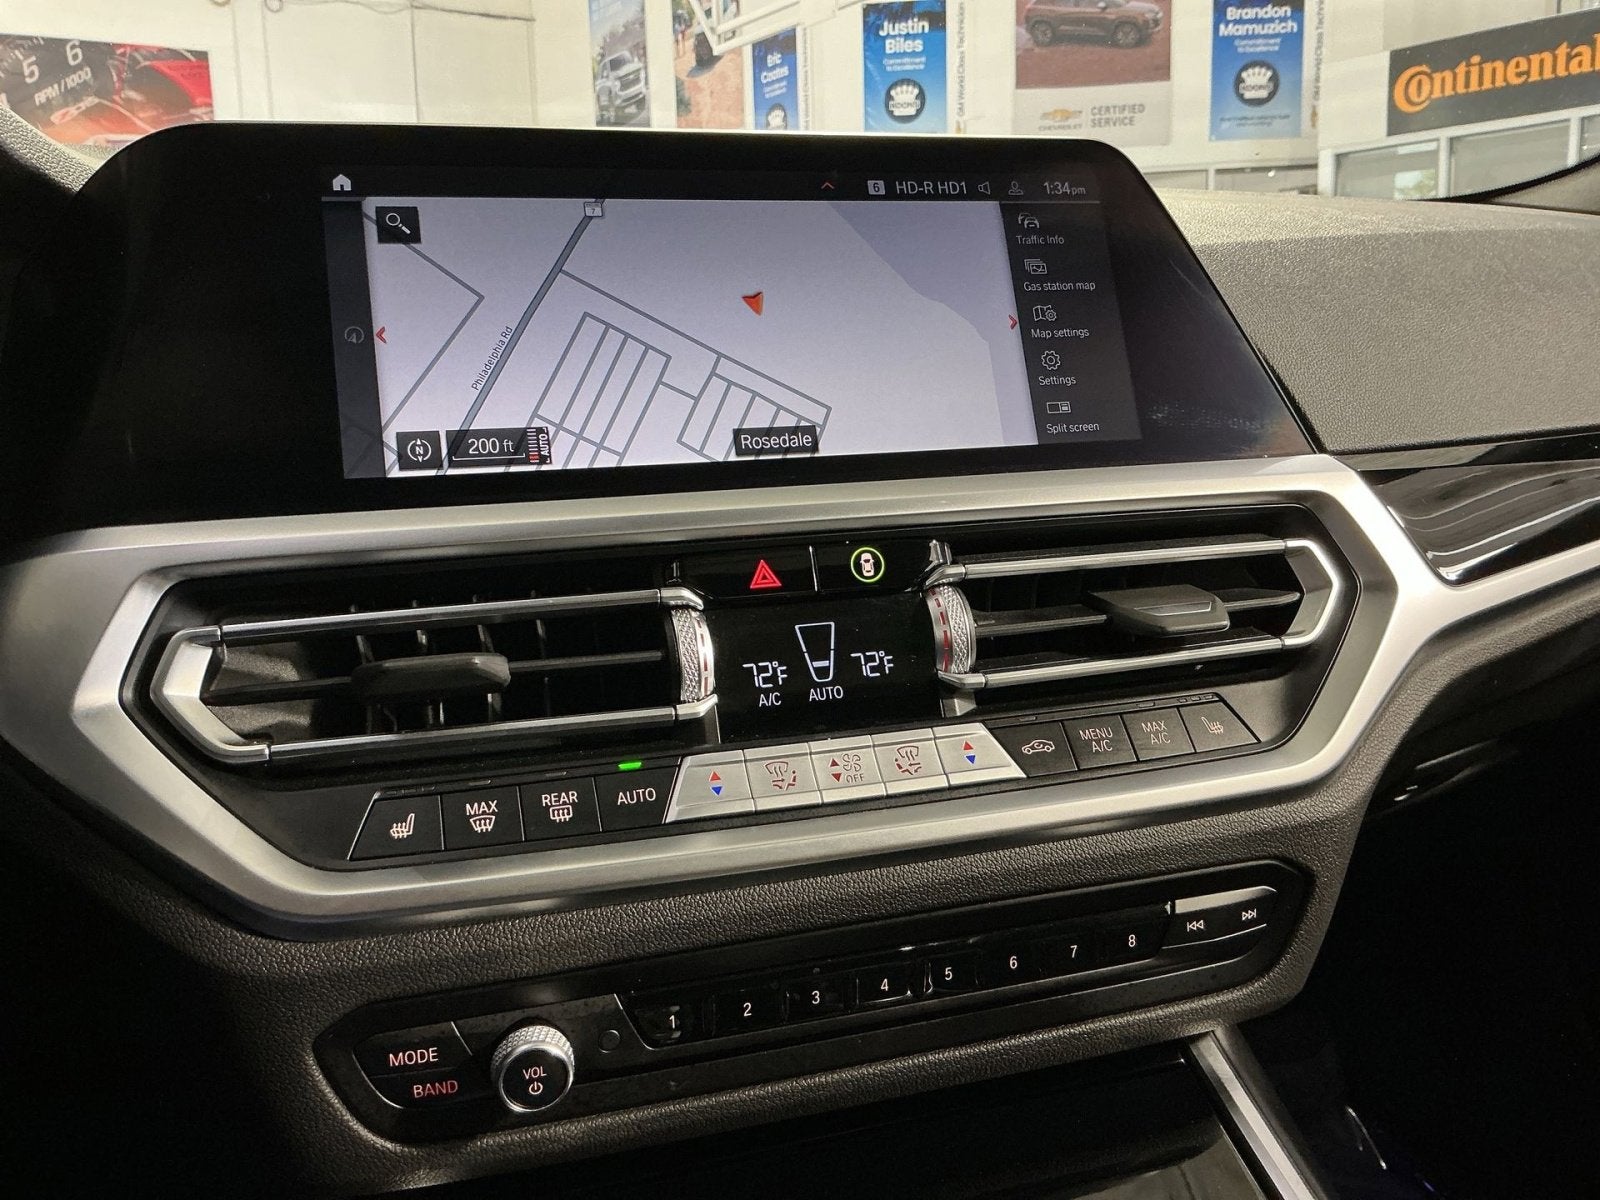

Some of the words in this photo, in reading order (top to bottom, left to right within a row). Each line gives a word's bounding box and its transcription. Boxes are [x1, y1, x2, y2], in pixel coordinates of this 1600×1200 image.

[1226, 4, 1292, 20] Brandon
[878, 17, 930, 36] Justin
[1219, 19, 1298, 37] Mamuzich
[66, 39, 83, 66] 6
[885, 36, 924, 54] Biles
[22, 55, 39, 84] 5
[1393, 32, 1600, 113] Continental
[1090, 103, 1146, 116] CERTIFIED
[1090, 116, 1135, 128] SERVICE
[896, 181, 933, 194] HD-R
[938, 181, 967, 195] HD1
[1015, 235, 1045, 246] Traffic
[1047, 235, 1065, 245] Info
[1023, 281, 1042, 292] Gas
[1043, 280, 1073, 291] station
[1075, 282, 1096, 293] map
[1030, 328, 1052, 340] Map
[1053, 327, 1090, 340] settings
[471, 340, 506, 390] Philadelphia
[501, 326, 513, 340] Rd
[1038, 374, 1077, 387] Settings
[1046, 423, 1068, 435] Split
[1069, 421, 1100, 433] screen
[467, 437, 500, 455] 200
[502, 437, 515, 454] ft
[539, 433, 550, 457] AUTO
[740, 432, 812, 449] Rosedale
[758, 692, 782, 707] A/C
[809, 685, 844, 702] AUTO
[1079, 727, 1112, 741] MENU
[1141, 720, 1168, 733] MAX
[1092, 739, 1114, 753] A/C
[1150, 732, 1171, 745] A/C
[846, 772, 865, 783] OFF
[541, 791, 578, 807] REAR
[617, 787, 656, 806] AUTO
[465, 800, 498, 816] MAX
[1127, 934, 1136, 948] 8
[1069, 945, 1078, 958] 7
[1009, 955, 1018, 969] 6
[944, 967, 953, 981] 5
[880, 978, 889, 992] 4
[811, 990, 820, 1005] 3
[743, 1002, 752, 1017] 2
[668, 1015, 676, 1029] 1
[388, 1047, 439, 1068] MODE
[522, 1066, 547, 1081] VOL
[412, 1079, 459, 1098] BAND
